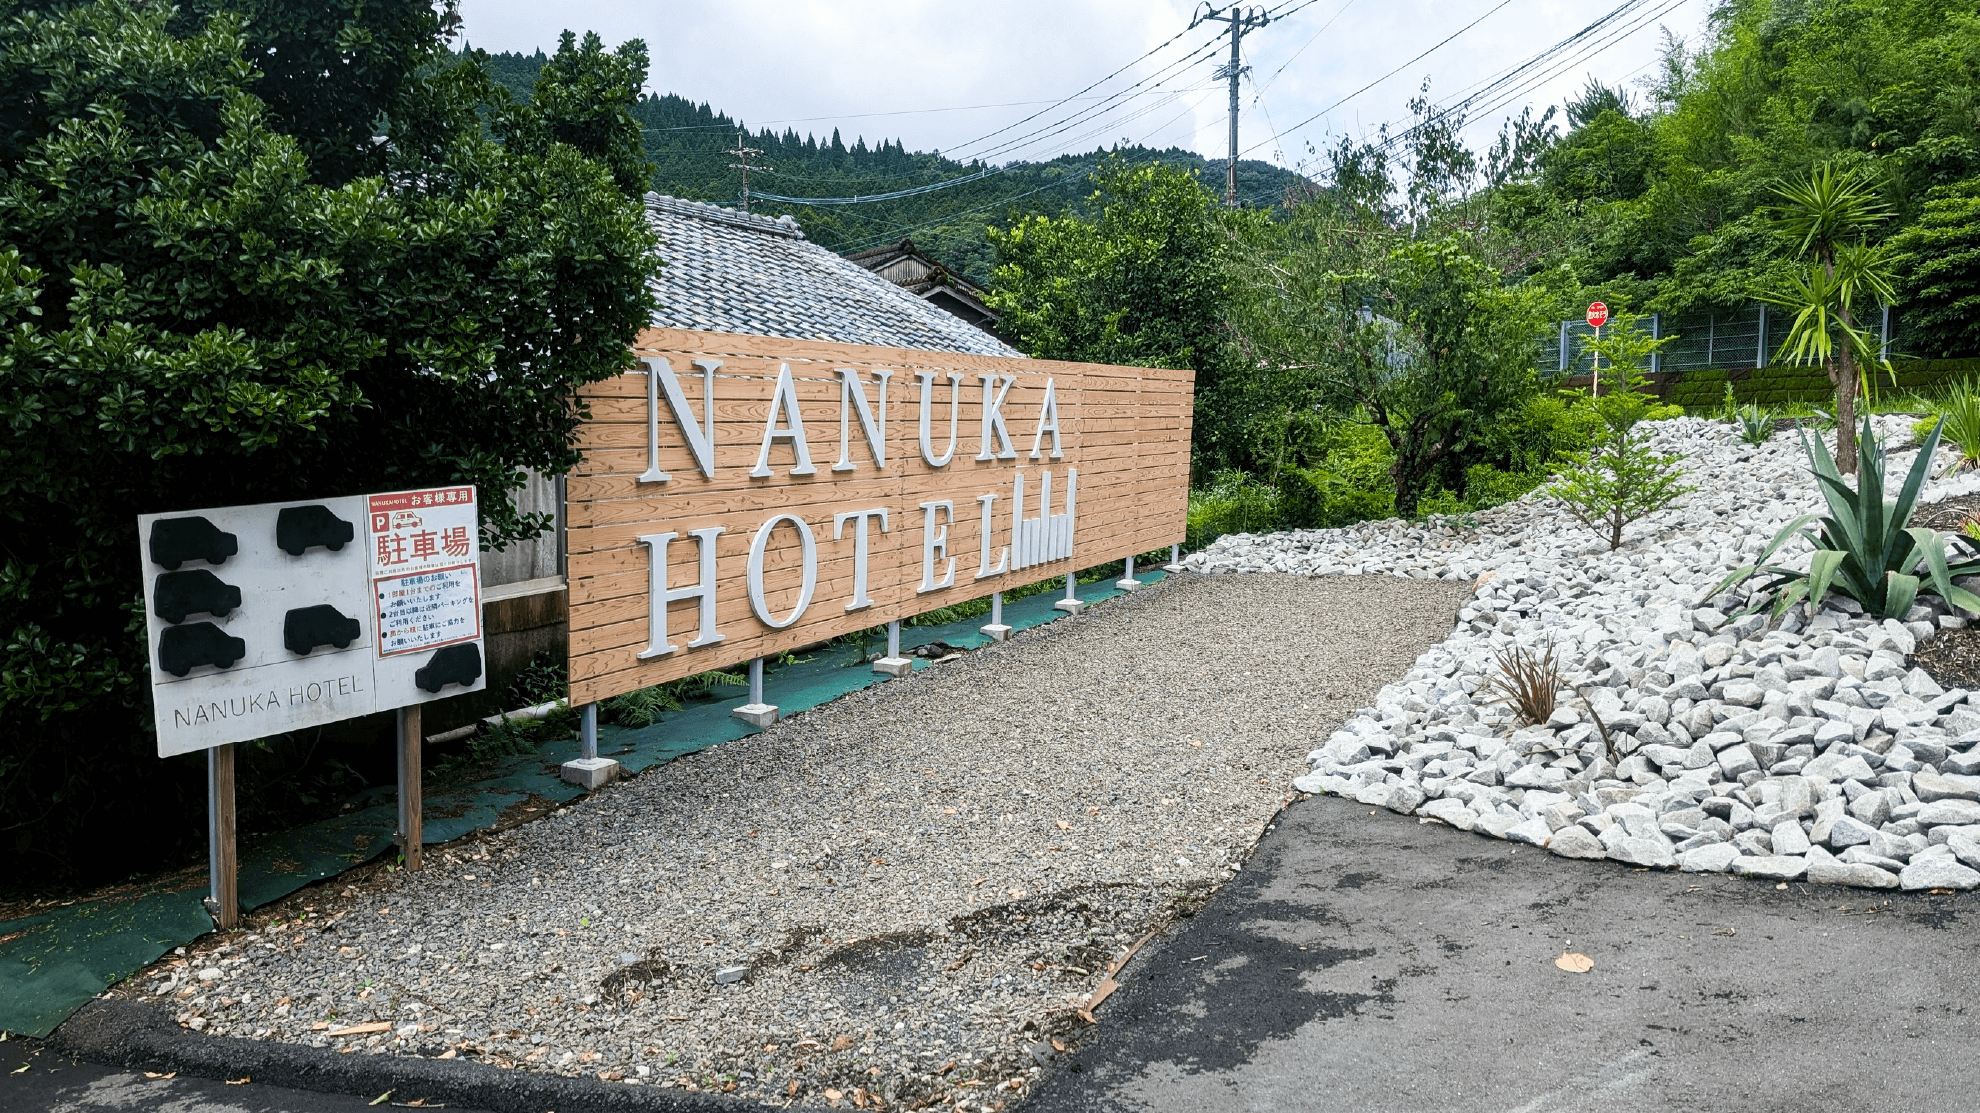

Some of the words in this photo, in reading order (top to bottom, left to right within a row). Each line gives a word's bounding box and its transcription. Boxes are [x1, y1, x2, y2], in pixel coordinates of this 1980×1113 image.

[635, 356, 1064, 484] NANUKA
[411, 490, 468, 506] お客様専用
[376, 516, 386, 531] P
[377, 526, 470, 567] 駐車場
[401, 572, 452, 587] 駐車場のお願い
[636, 494, 1009, 660] HOTEL
[389, 614, 435, 628] ご利用ください
[391, 631, 442, 647] お願いいたします
[174, 690, 281, 729] NANUKA
[289, 675, 364, 706] HOTEL
